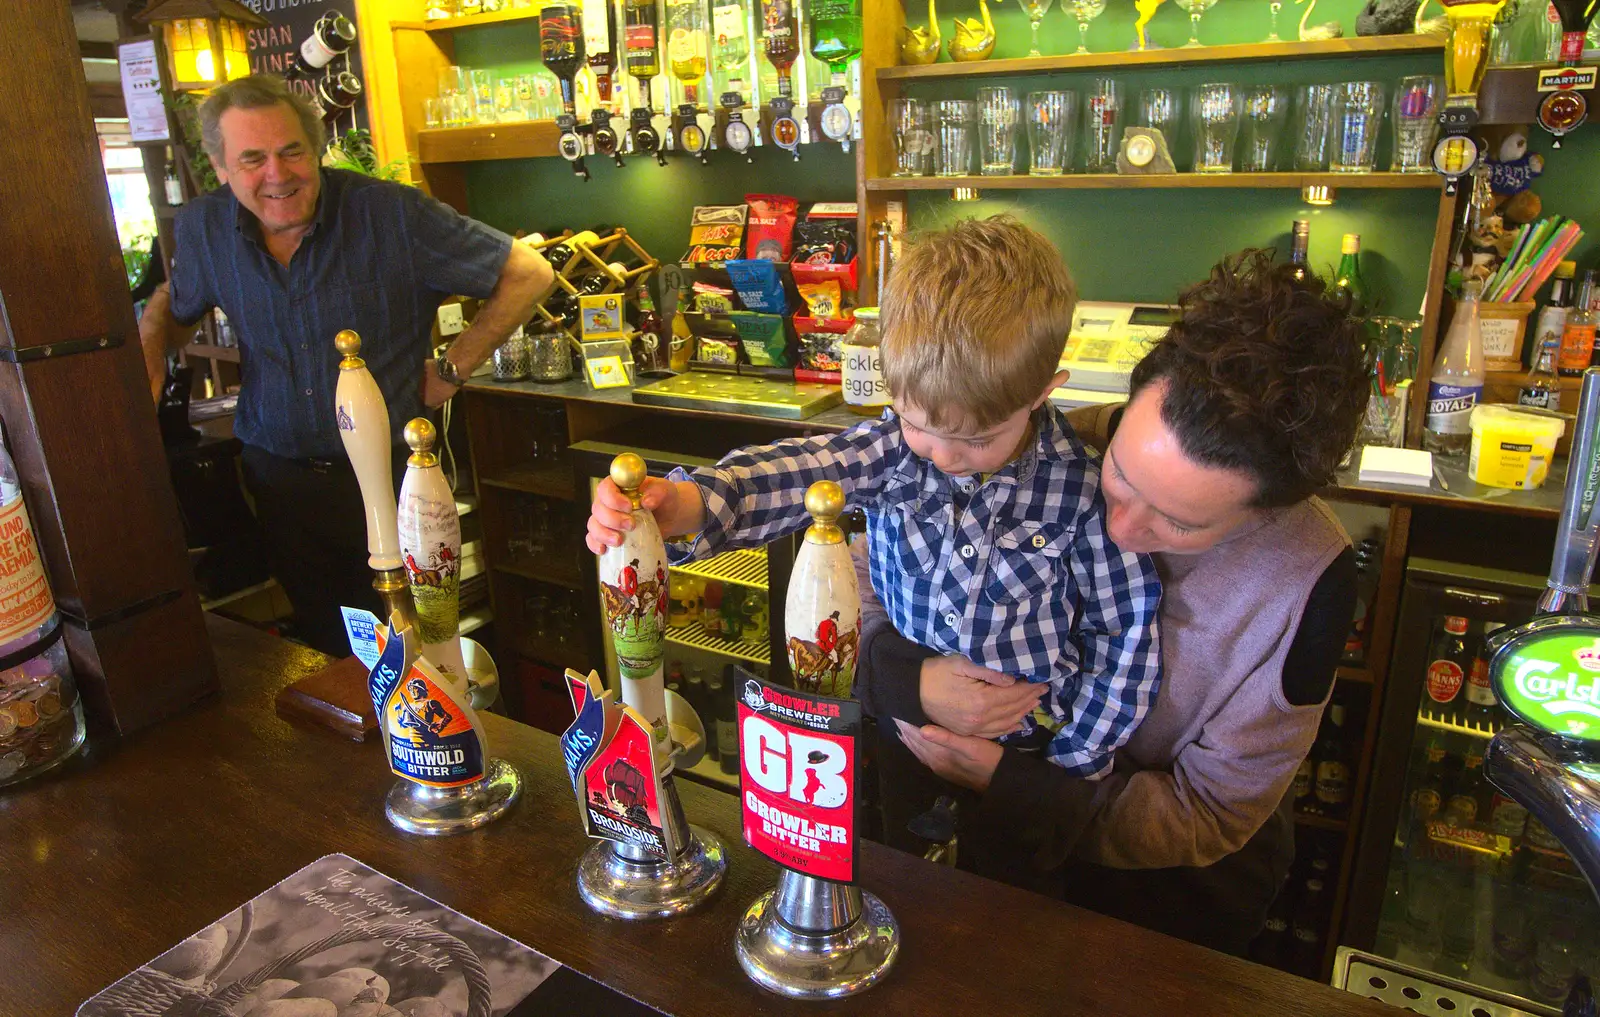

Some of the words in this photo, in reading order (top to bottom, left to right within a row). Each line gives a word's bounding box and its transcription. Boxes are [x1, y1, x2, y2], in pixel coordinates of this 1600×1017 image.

[248, 25, 292, 50] SWAN
[1544, 75, 1591, 85] MARTINI
[760, 218, 777, 226] SALT
[687, 245, 740, 262] Mars
[845, 378, 884, 397] eggs
[1429, 399, 1467, 413] ROYAL
[0, 515, 24, 539] UND
[16, 528, 33, 553] FOR
[763, 686, 840, 717] GROWLER
[769, 703, 832, 723] BREWERY
[391, 741, 465, 766] SOUTHWOLD
[743, 716, 847, 809] GB
[407, 763, 449, 776] BITTER
[588, 808, 662, 848] BROADSIDE
[745, 791, 847, 844] GROWLER
[762, 820, 820, 852] BITTER
[791, 856, 808, 867] ABV
[328, 868, 356, 888] The
[408, 919, 439, 930] at
